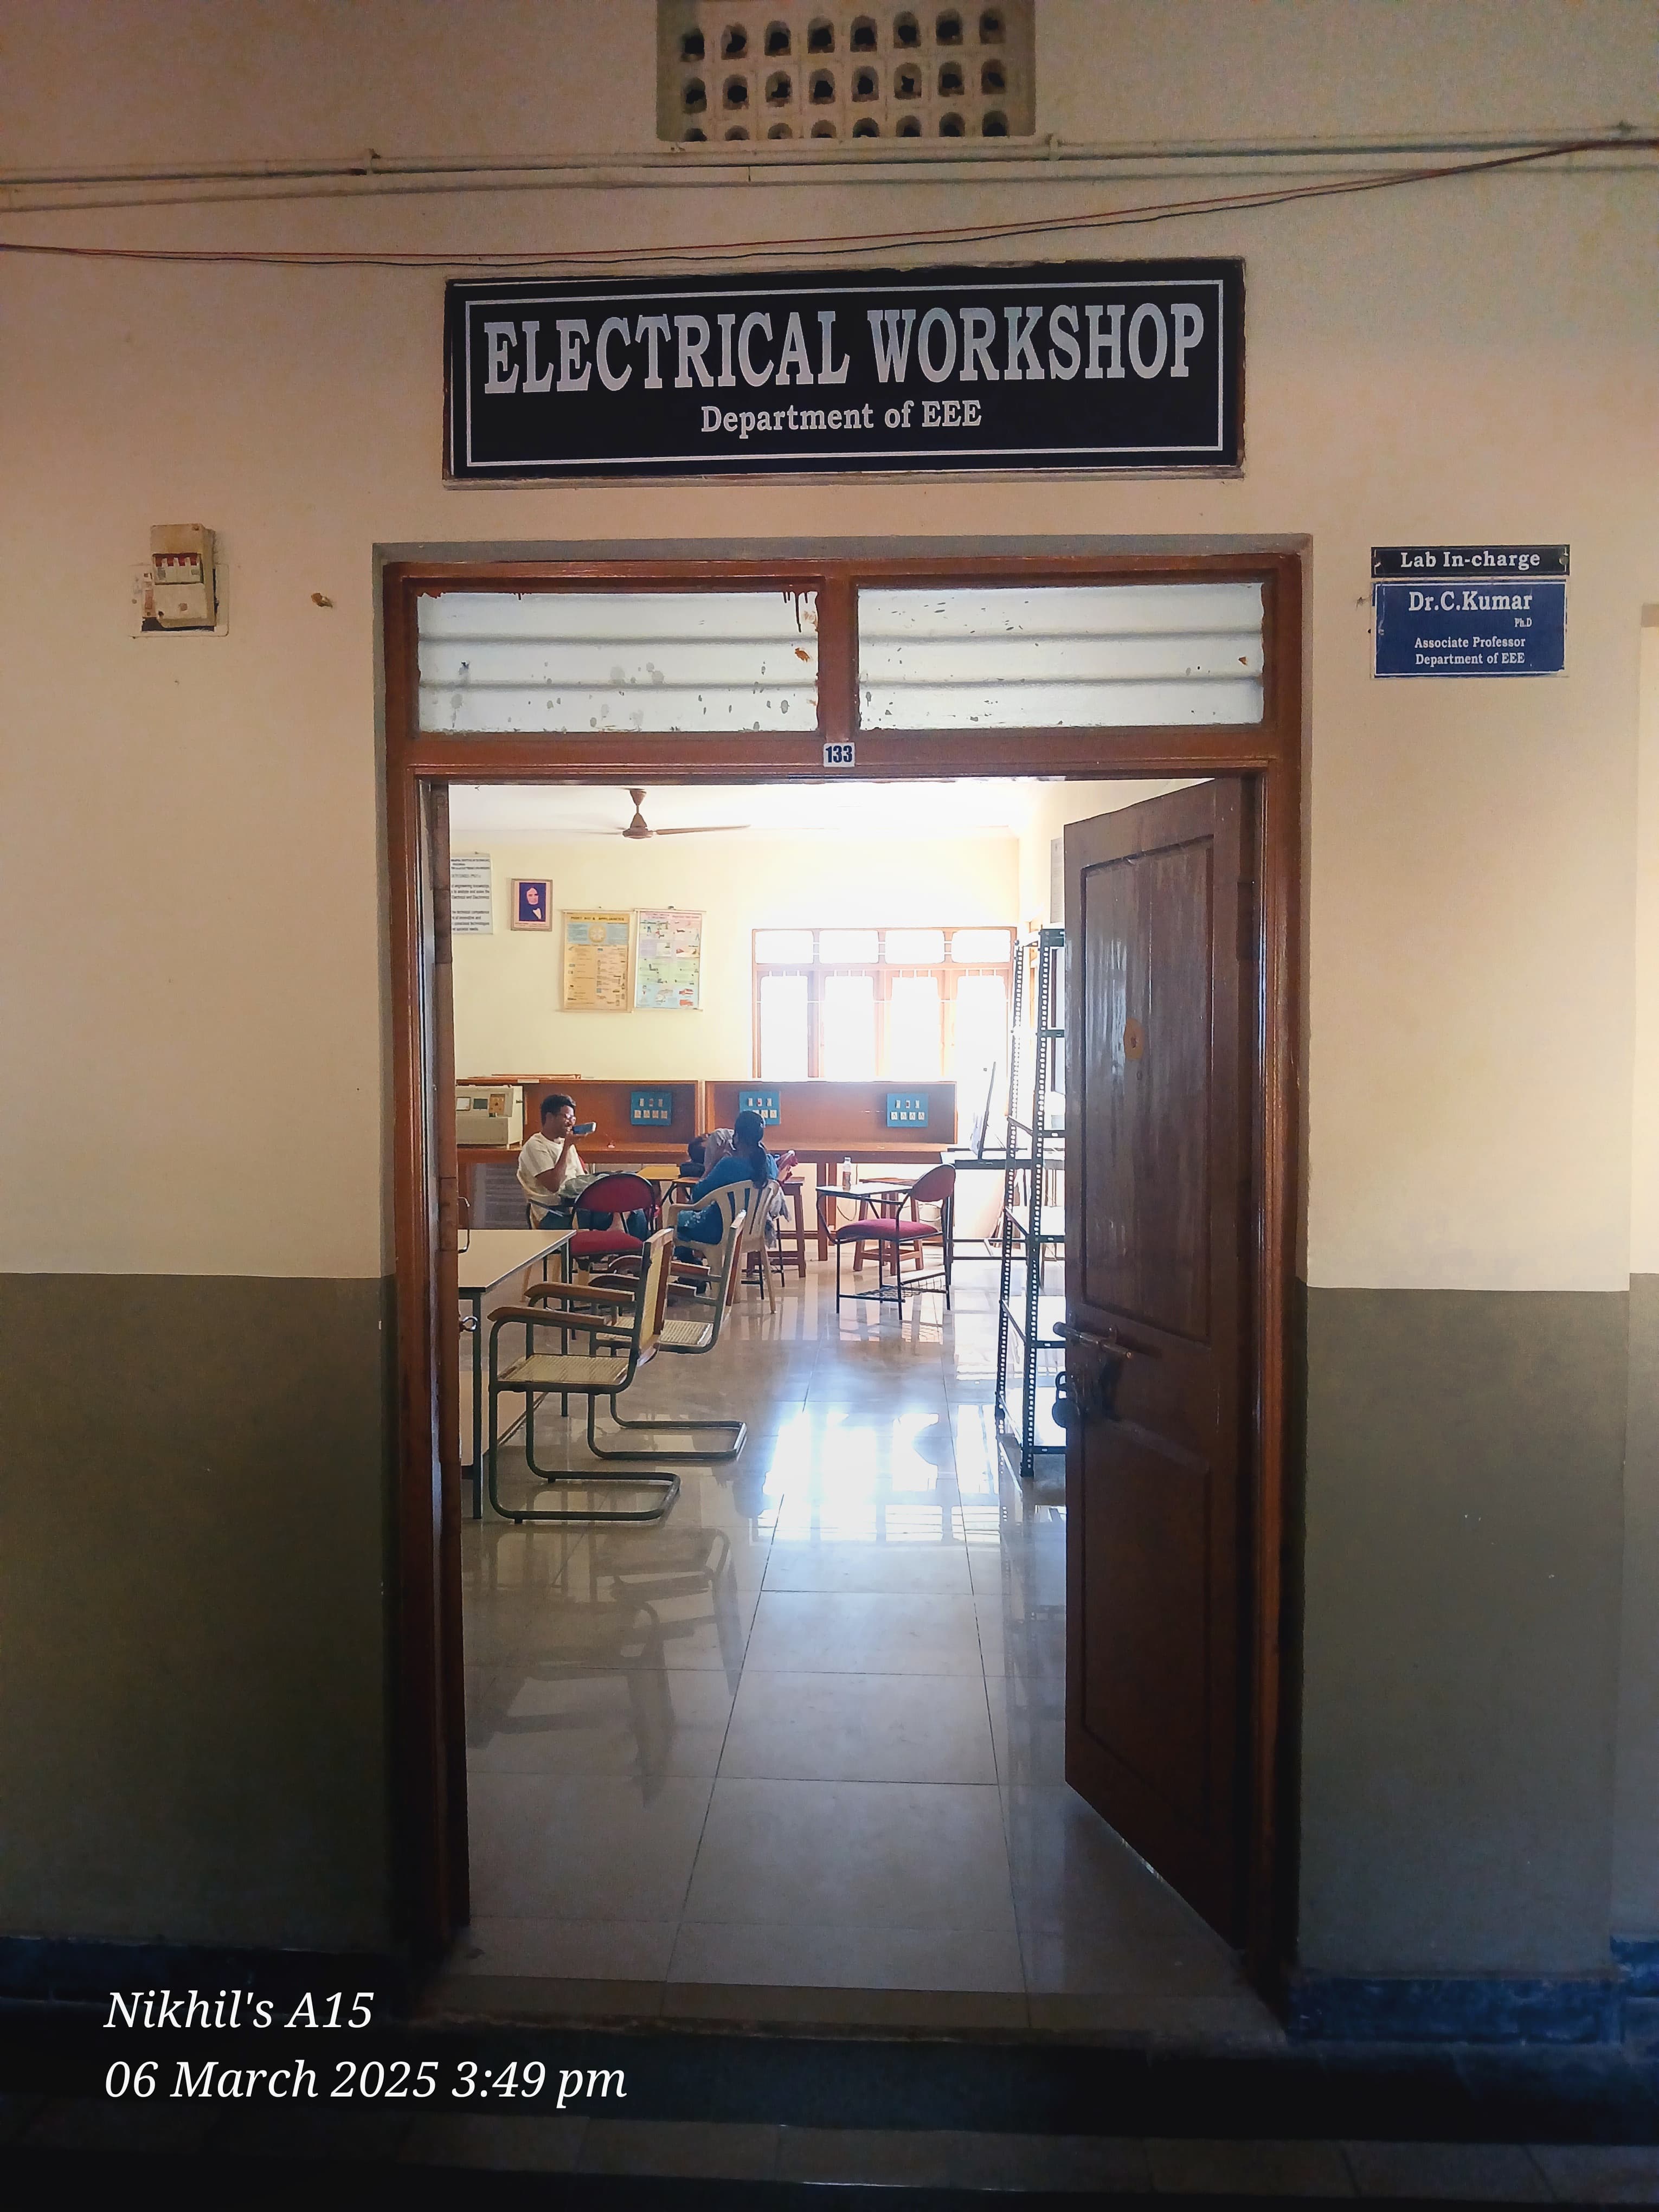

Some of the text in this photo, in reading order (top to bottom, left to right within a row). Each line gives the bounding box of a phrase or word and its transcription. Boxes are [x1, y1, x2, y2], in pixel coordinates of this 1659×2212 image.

[484, 303, 1204, 394] ELECTRICAL WORKSHOP
[701, 400, 982, 439] Department of EEE
[1400, 550, 1541, 570] Lab In-charge
[1409, 591, 1533, 611] Dr.C.Kumar
[1514, 617, 1532, 628] Ph.D
[1414, 635, 1526, 648] Associate Professor
[1415, 652, 1525, 668] Department of EEE
[825, 745, 852, 763] 133
